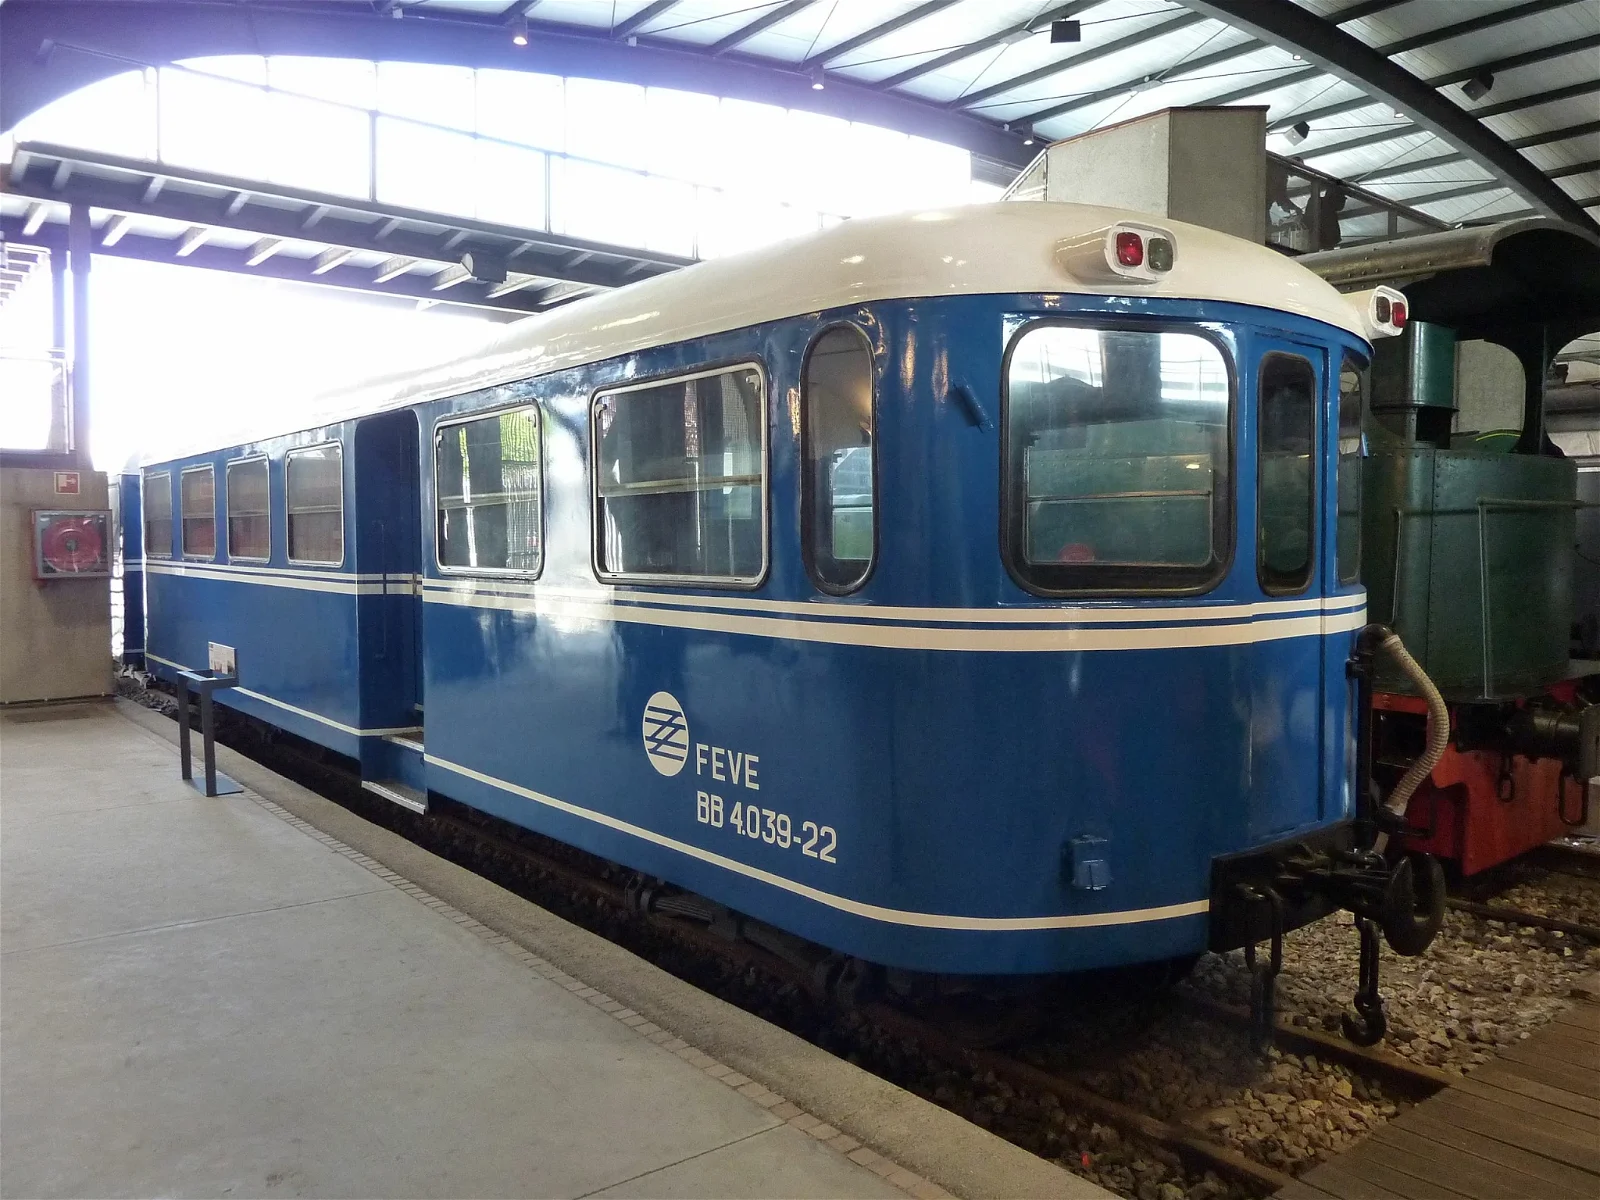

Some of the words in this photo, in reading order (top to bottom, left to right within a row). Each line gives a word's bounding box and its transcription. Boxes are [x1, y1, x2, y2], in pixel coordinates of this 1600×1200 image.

[696, 742, 760, 791] FEVE
[697, 790, 724, 828] BB
[730, 801, 837, 864] 4.039-22
